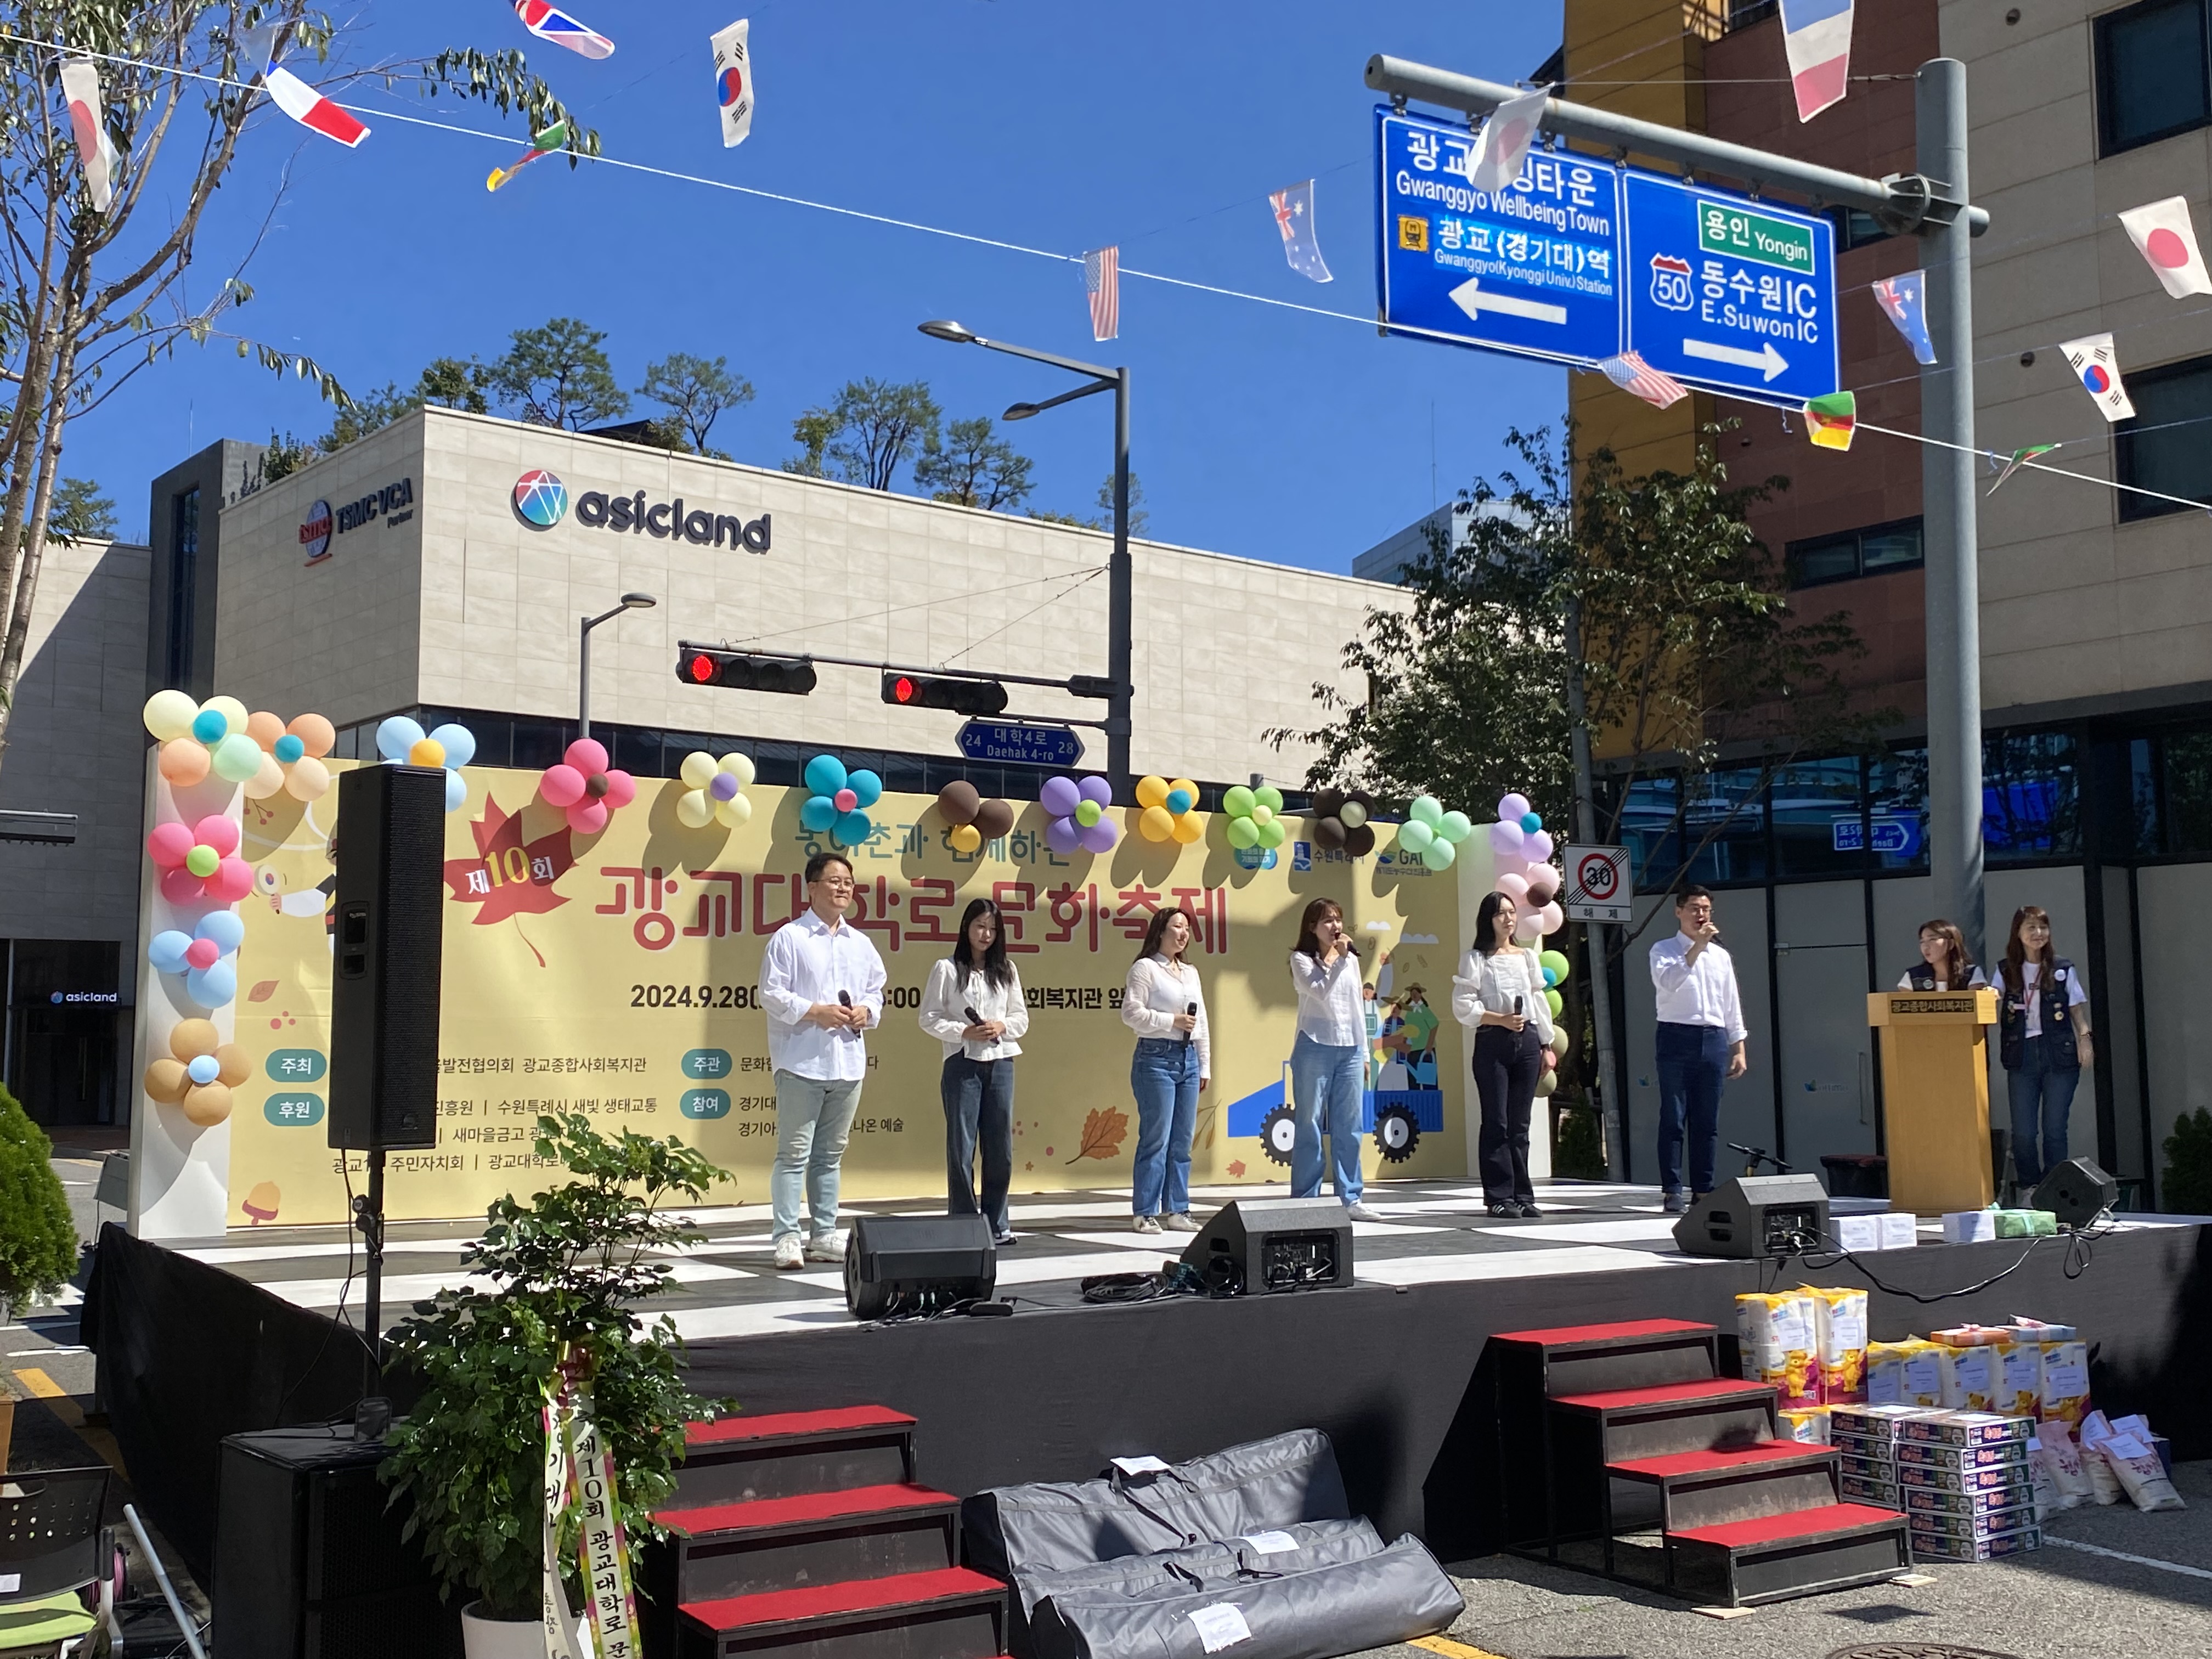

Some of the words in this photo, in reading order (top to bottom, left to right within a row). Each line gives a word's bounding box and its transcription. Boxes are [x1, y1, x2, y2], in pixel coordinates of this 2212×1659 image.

[1396, 170, 1487, 213] Gwanggyo
[1706, 210, 1750, 247] 용인
[1754, 231, 1808, 262] Yongin
[1576, 279, 1612, 296] Station
[1658, 274, 1686, 303] 50
[336, 494, 377, 534] TSMC
[377, 477, 413, 515] VCA
[575, 489, 771, 555] asicland
[966, 733, 981, 747] 24
[994, 727, 1048, 747] 대학4로
[987, 744, 1028, 759] Daehak
[1031, 750, 1054, 761] 4-ro
[1058, 741, 1074, 754] 28
[465, 847, 555, 894] 제10회
[1586, 866, 1611, 887] 30
[992, 881, 1226, 953] 문화축제
[66, 991, 117, 1002] asicland
[630, 984, 762, 1009] 2024.9.28(
[1022, 987, 1103, 1009] 회복지관
[280, 1057, 312, 1075] 주최
[522, 1057, 647, 1073] 광교종합사회복지관
[693, 1056, 720, 1072] 주관
[279, 1101, 310, 1118] 후원
[498, 1099, 567, 1115] 수원특례시
[572, 1099, 599, 1114] 새빛
[603, 1098, 658, 1114] 생태교통
[692, 1096, 719, 1113] 참여
[453, 1127, 524, 1143] 새마을금고
[738, 1121, 778, 1137] 경기아
[881, 1118, 905, 1132] 예술
[390, 1155, 464, 1172] 주민자치회
[488, 1153, 566, 1170] 광교대학로
[575, 1435, 605, 1520] 제10회
[590, 1530, 628, 1635] 광교대학로
